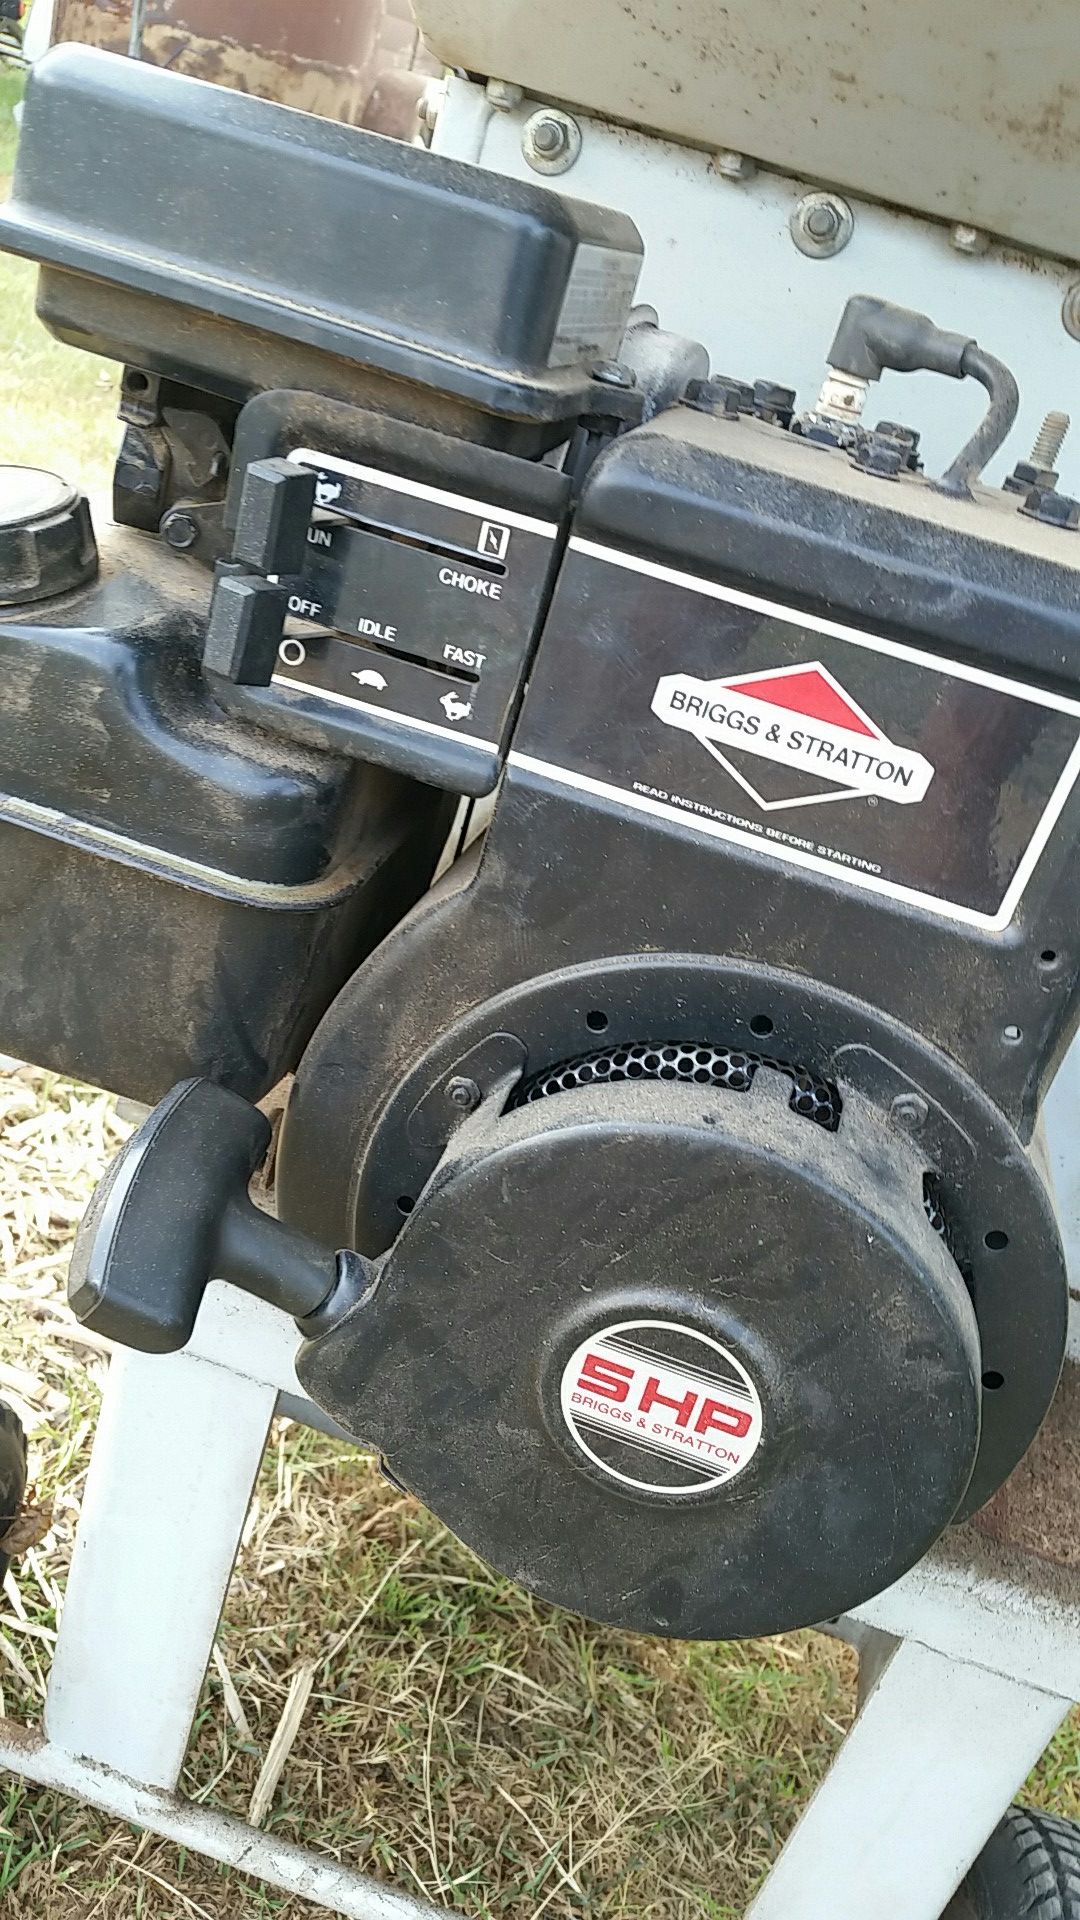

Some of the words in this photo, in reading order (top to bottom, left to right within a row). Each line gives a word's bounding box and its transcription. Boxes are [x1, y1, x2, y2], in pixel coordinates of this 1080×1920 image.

[306, 526, 332, 547] UN
[438, 568, 503, 601] CHOKE
[287, 595, 322, 617] OFF
[357, 617, 398, 642] IDLE
[443, 644, 487, 670] FAST
[669, 690, 761, 735] BRIGGS
[765, 723, 780, 743] &
[787, 730, 914, 786] STRATTON
[632, 781, 668, 801] READ
[671, 794, 764, 833] INSTRUCTIONS
[766, 827, 815, 851] BEFORE
[817, 844, 882, 874] STARTING
[571, 1392, 632, 1422] BRIGGS
[636, 1417, 646, 1429] &
[651, 1423, 741, 1464] STRATTON
